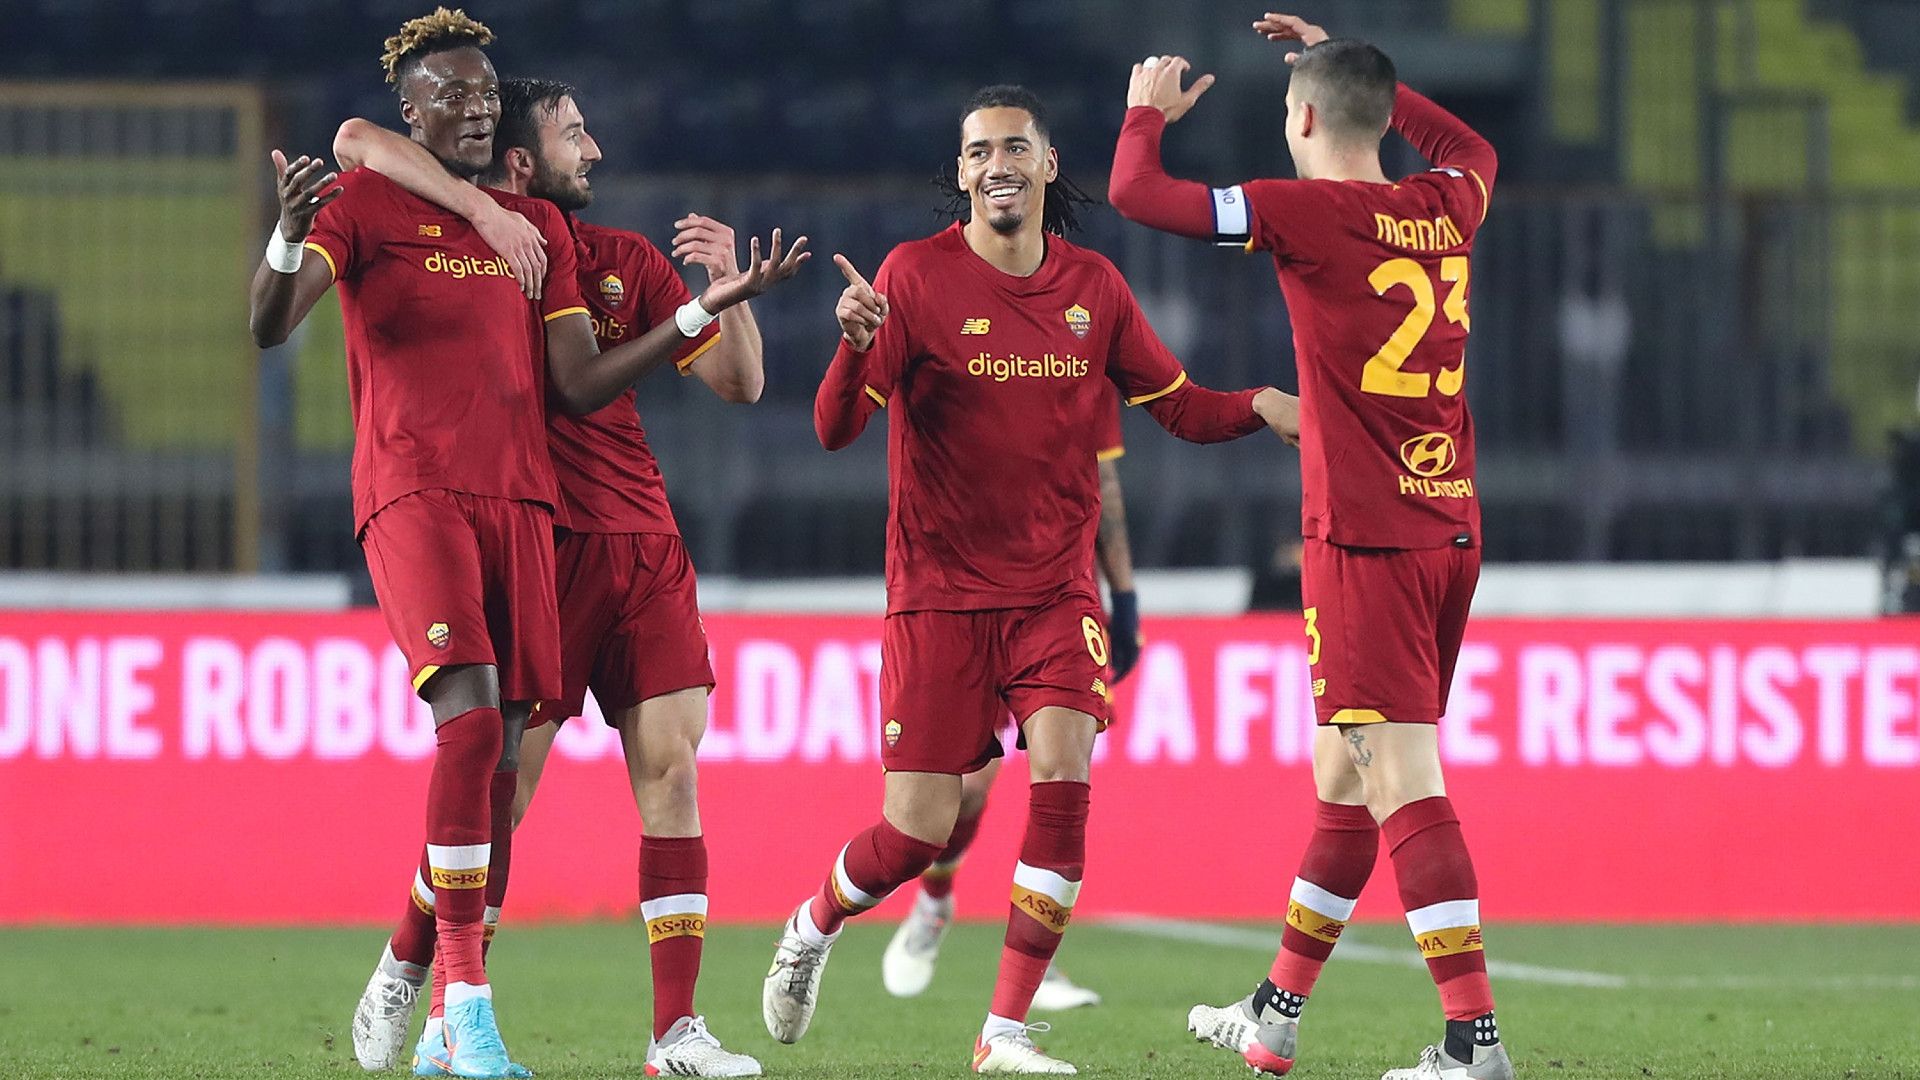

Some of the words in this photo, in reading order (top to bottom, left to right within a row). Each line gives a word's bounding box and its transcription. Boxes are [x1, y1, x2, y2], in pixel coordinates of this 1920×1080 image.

[1360, 255, 1471, 399] 23
[967, 352, 1089, 383] digitalbits
[1081, 615, 1108, 668] 6
[1303, 606, 1322, 666] 3
[181, 636, 438, 762] ROBO
[1126, 641, 1199, 764] A
[1517, 642, 1920, 768] RESISTE
[433, 871, 486, 884] AS-RO
[651, 919, 704, 937] AS-RO
